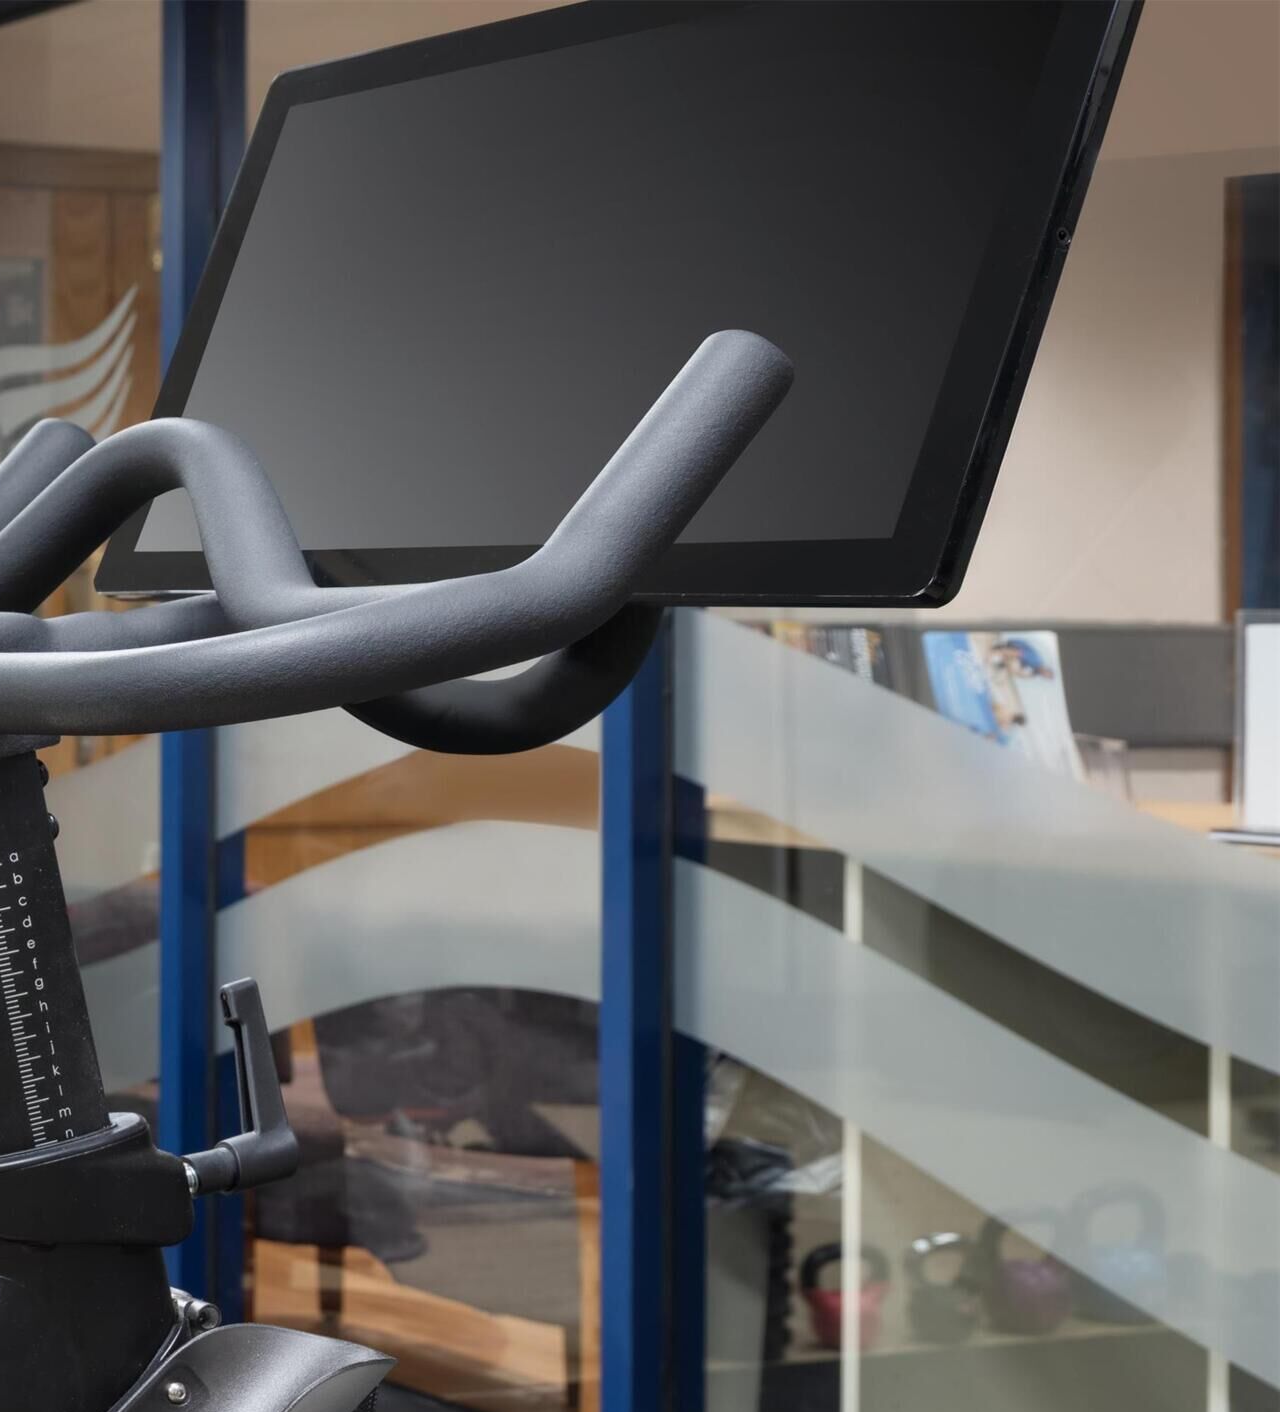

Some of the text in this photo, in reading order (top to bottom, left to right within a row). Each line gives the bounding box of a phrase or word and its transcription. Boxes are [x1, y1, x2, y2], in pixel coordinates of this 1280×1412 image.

[9, 852, 19, 863] a
[13, 872, 23, 885] b
[18, 896, 28, 906] c
[22, 915, 32, 928] d
[26, 939, 36, 949] e
[32, 957, 38, 970] f
[34, 977, 44, 990] g
[39, 1000, 49, 1012] h
[49, 1039, 56, 1056] j
[51, 1064, 61, 1076] k
[59, 1106, 72, 1118] m
[65, 1128, 74, 1139] n
